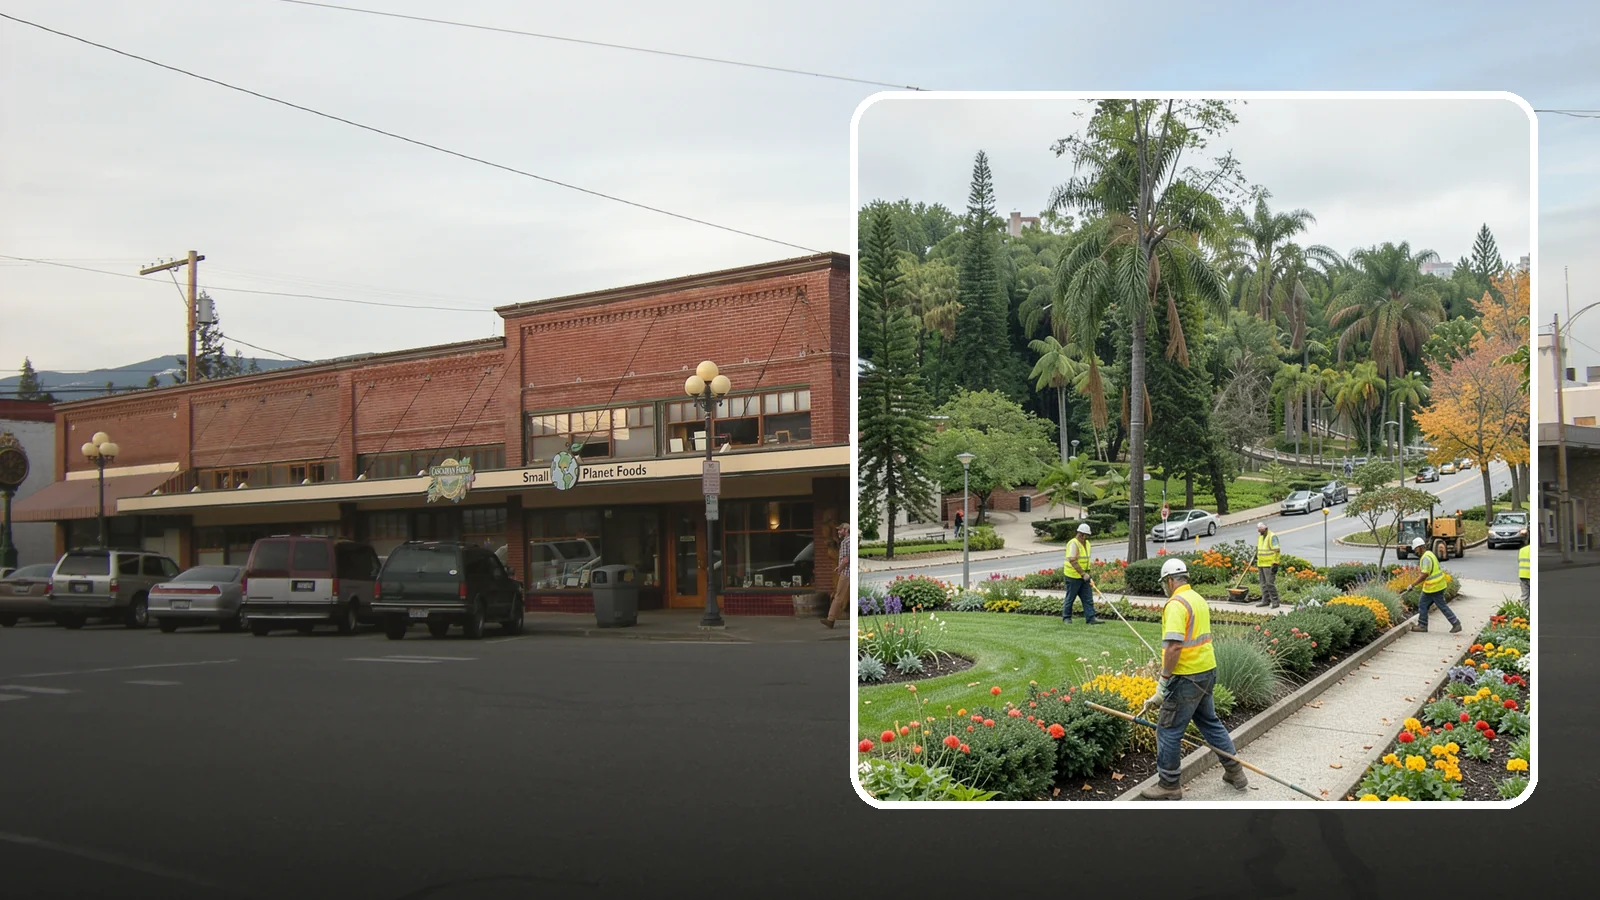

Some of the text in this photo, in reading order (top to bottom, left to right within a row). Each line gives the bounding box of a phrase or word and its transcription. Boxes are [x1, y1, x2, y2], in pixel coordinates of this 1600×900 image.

[523, 464, 647, 483] Small Planet Foods
